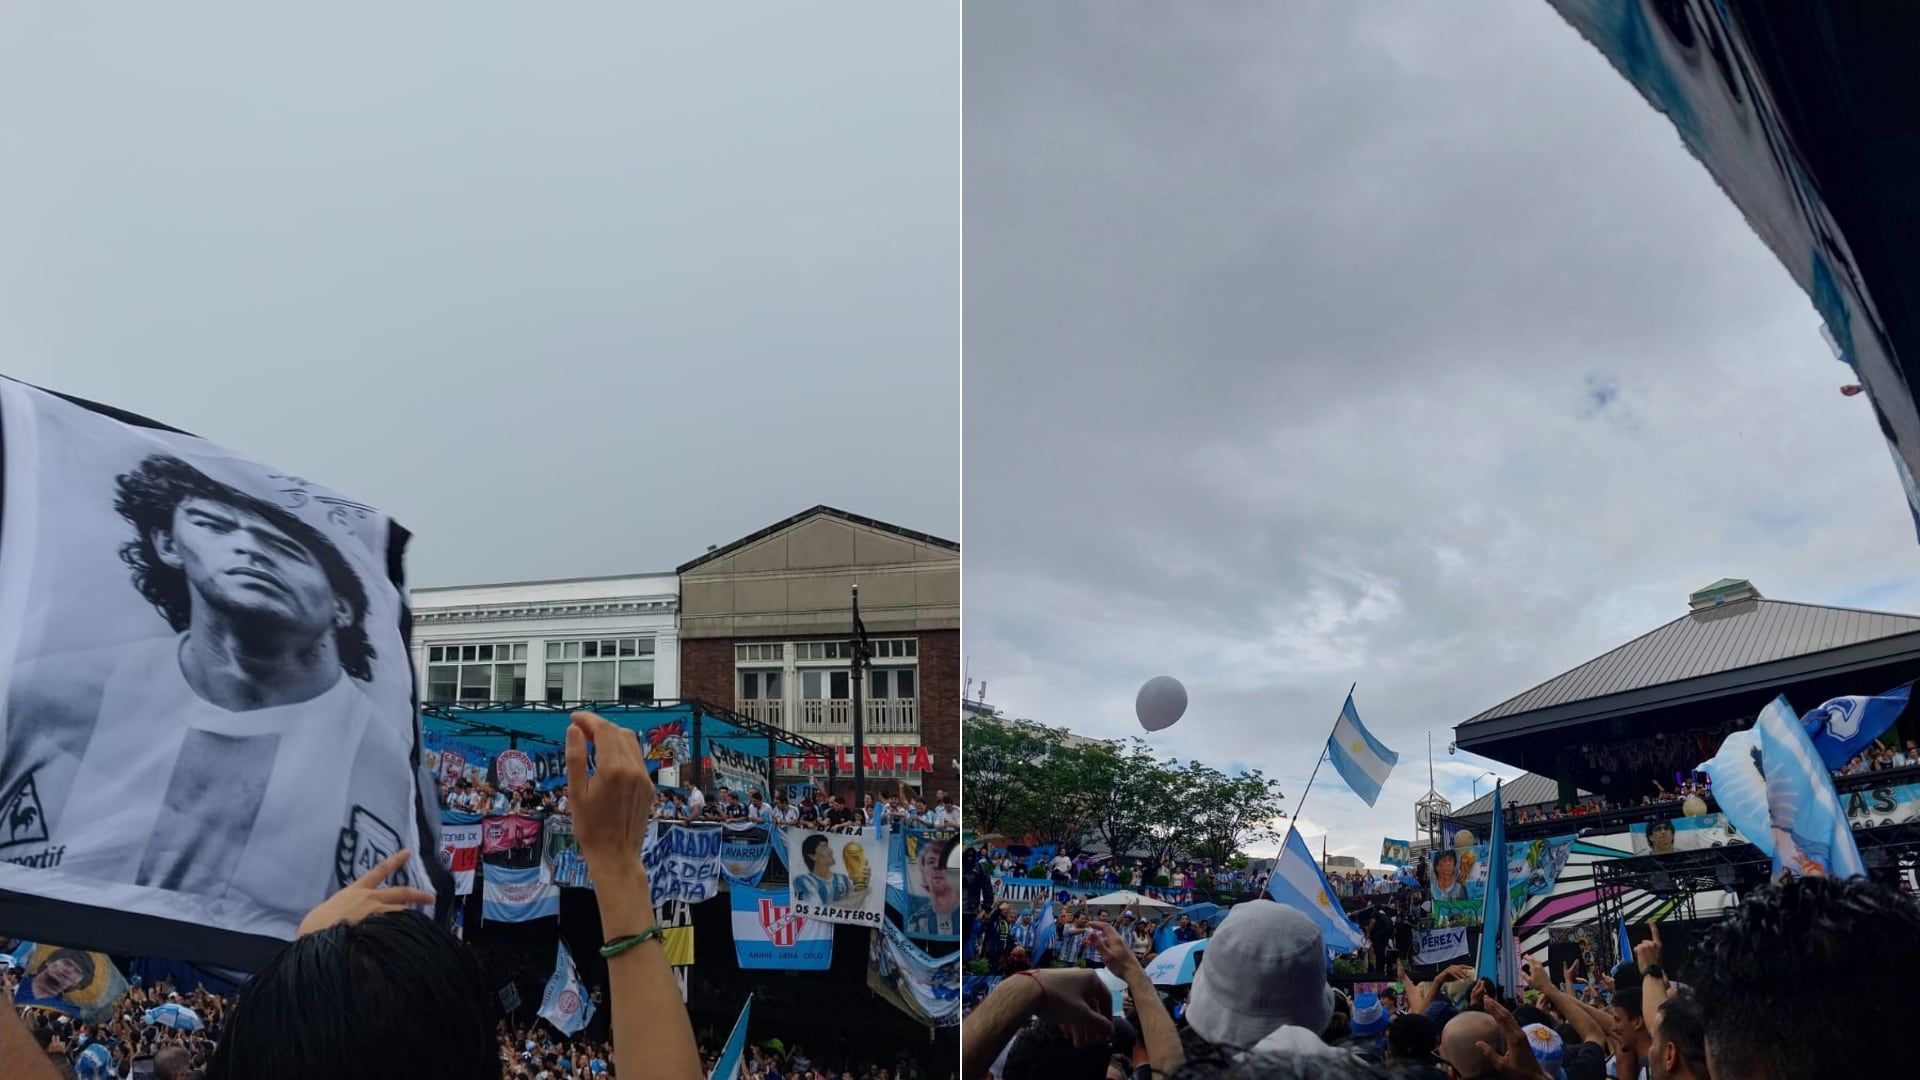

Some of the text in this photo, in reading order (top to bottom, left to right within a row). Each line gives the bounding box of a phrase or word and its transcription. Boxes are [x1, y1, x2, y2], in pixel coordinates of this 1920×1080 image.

[682, 862, 718, 881] DEL
[795, 903, 880, 923] OS ZAPATEROS
